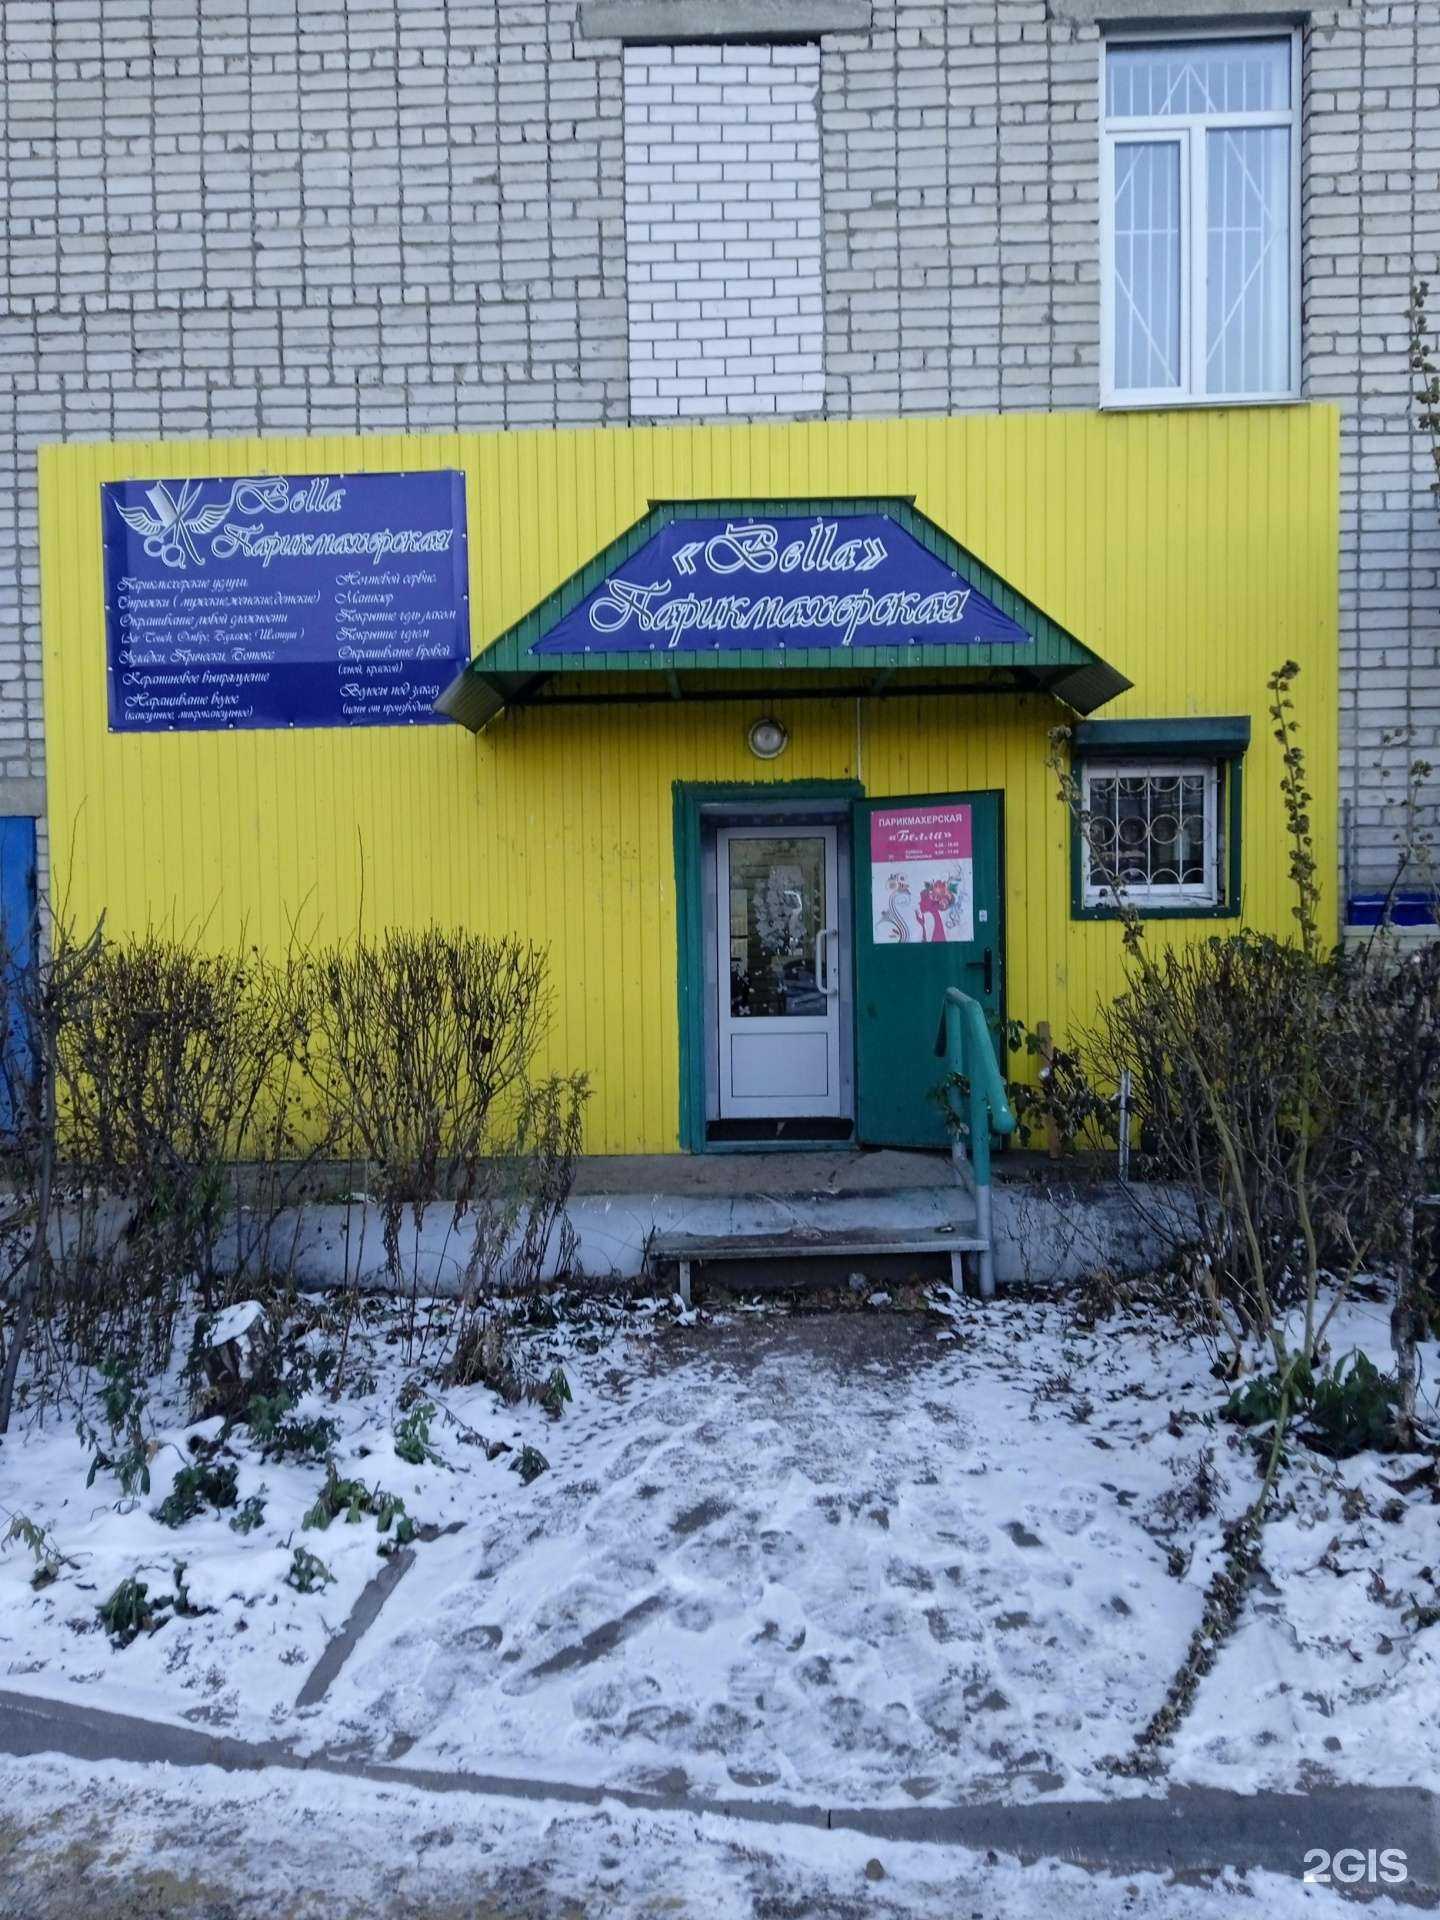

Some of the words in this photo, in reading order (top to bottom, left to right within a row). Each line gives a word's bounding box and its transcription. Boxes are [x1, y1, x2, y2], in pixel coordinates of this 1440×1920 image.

[235, 478, 346, 514] Bella
[211, 523, 453, 567] Парикмахерская
[335, 589, 393, 606] Маникюр
[589, 580, 970, 647] Парикмахерская
[878, 813, 963, 827] ПАРИКМАХЕРСКАЯ
